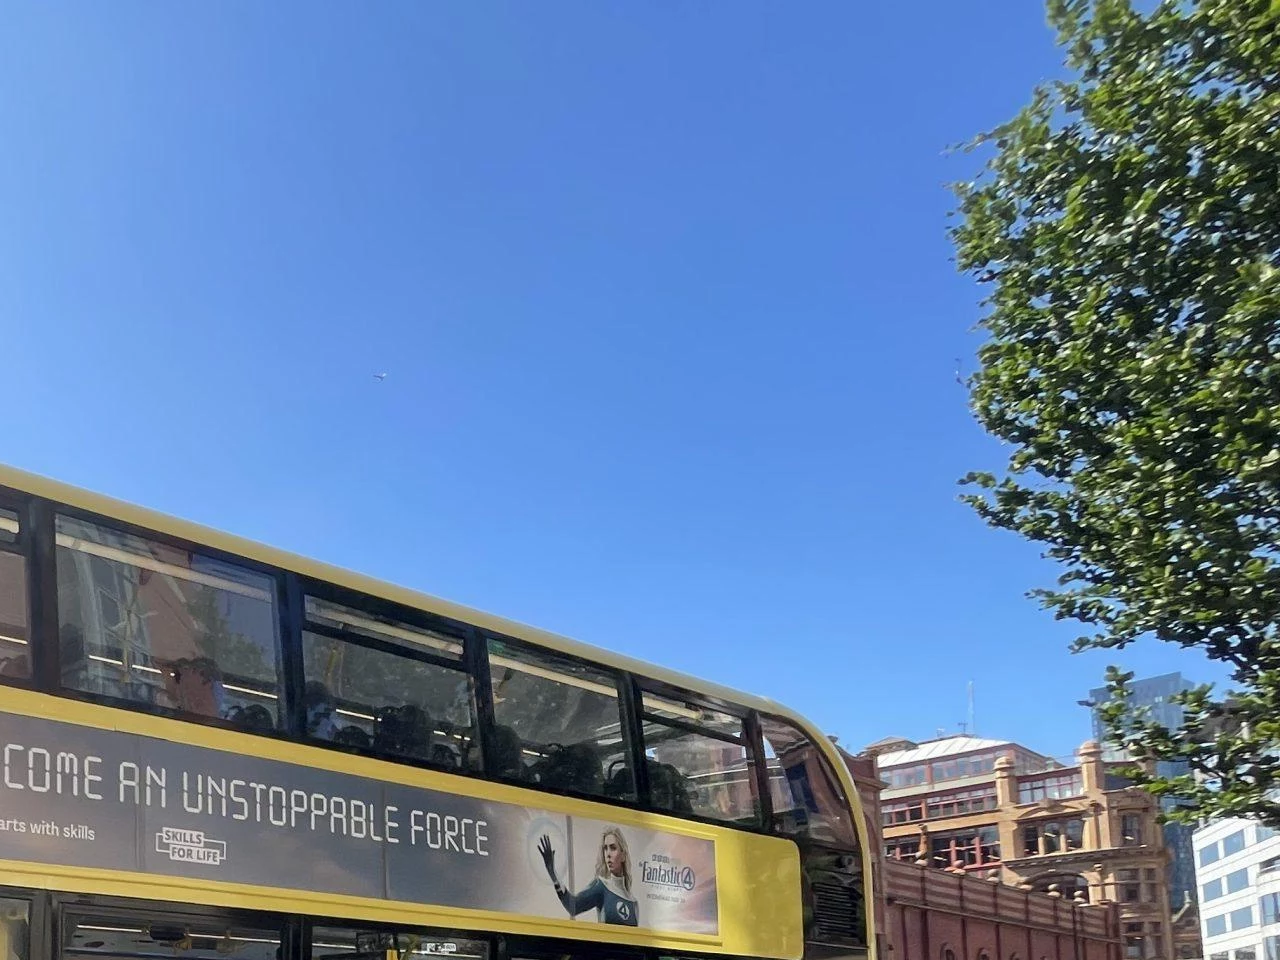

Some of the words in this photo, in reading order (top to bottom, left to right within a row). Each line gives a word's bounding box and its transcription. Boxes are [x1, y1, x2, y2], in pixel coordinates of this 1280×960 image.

[120, 762, 166, 808] AN
[183, 771, 399, 844] UNSTOPPABLE
[411, 809, 489, 856] FORCE
[30, 820, 59, 836] with
[63, 824, 96, 841] skills
[164, 829, 202, 845] SKILLS
[171, 846, 194, 860] FOR
[196, 849, 219, 863] LIFE
